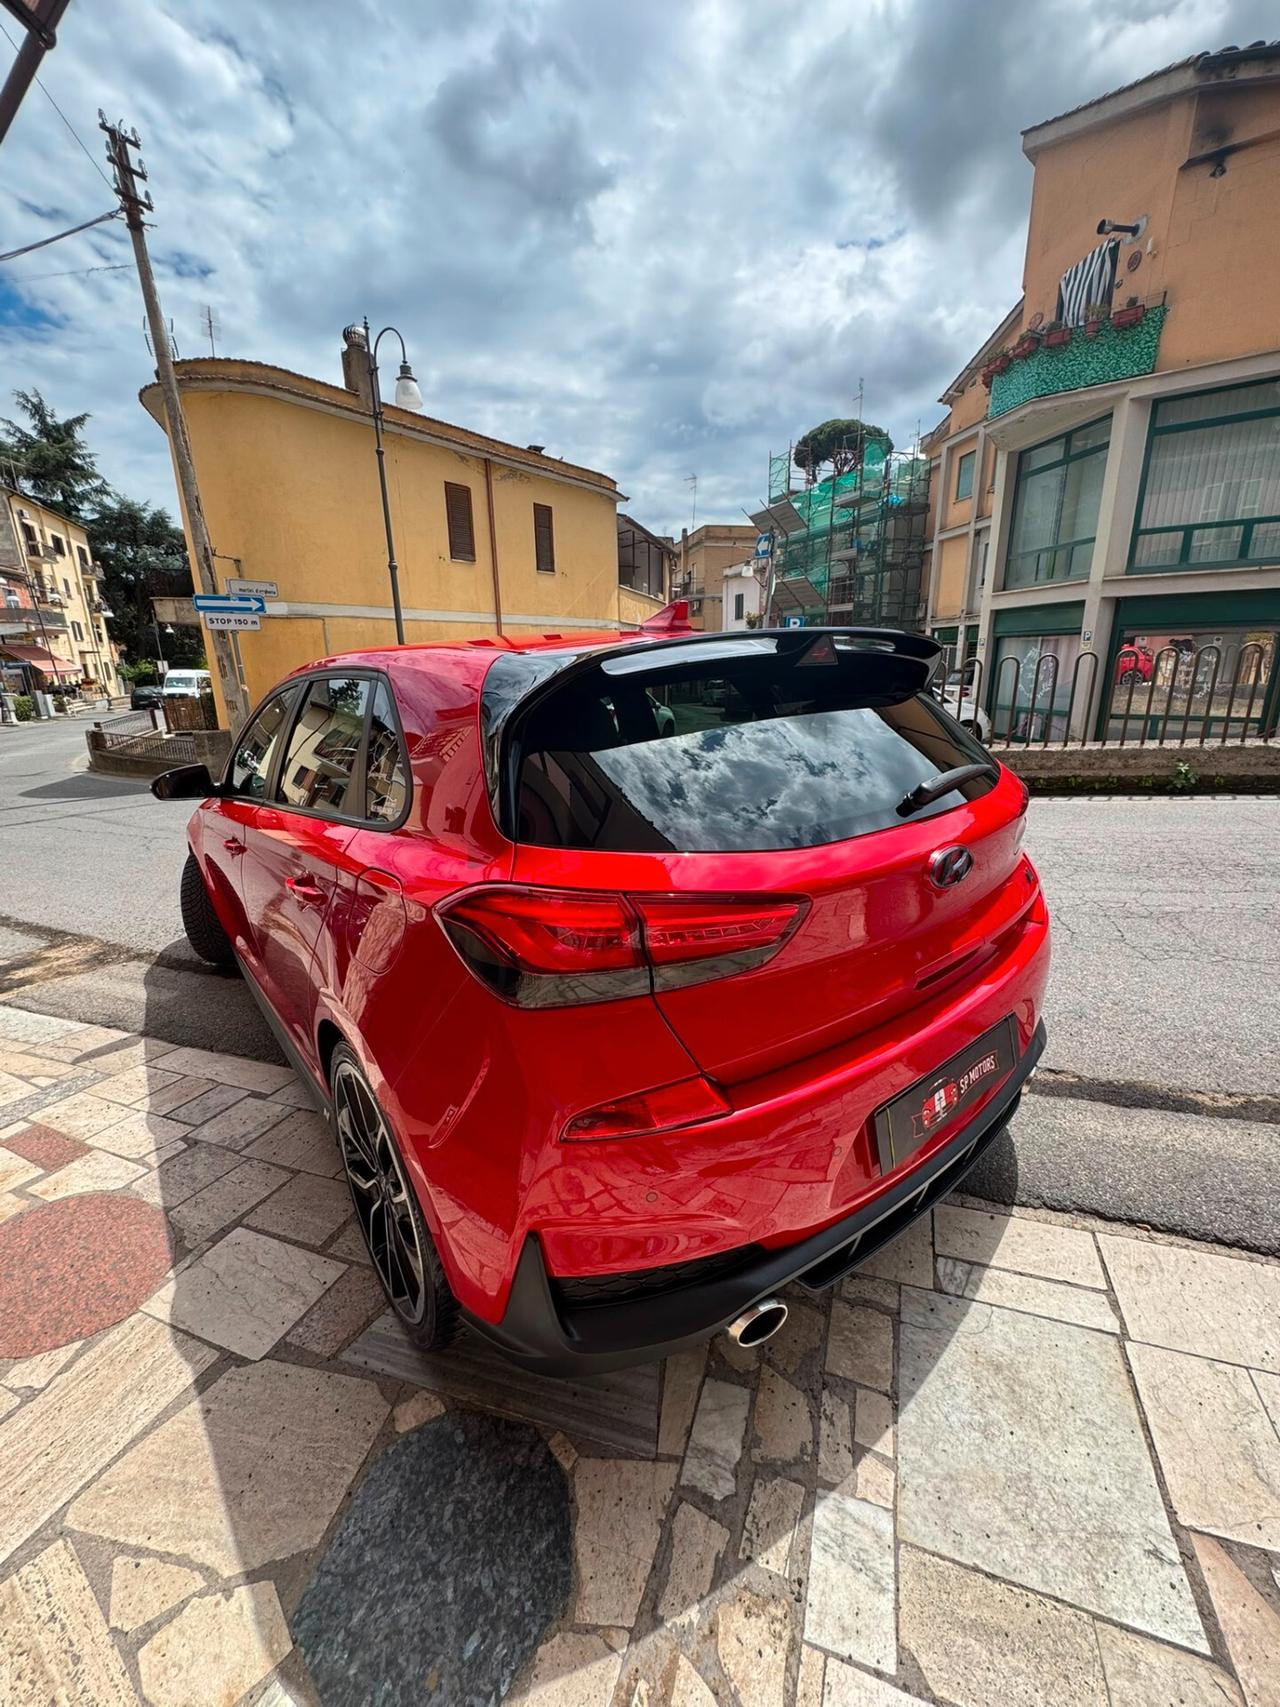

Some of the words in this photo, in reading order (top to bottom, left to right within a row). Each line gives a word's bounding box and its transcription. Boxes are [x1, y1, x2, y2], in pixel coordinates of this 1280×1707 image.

[234, 618, 248, 626] 150
[1084, 631, 1091, 640] P
[959, 1075, 969, 1093] SP
[969, 1055, 995, 1084] MOTORS
